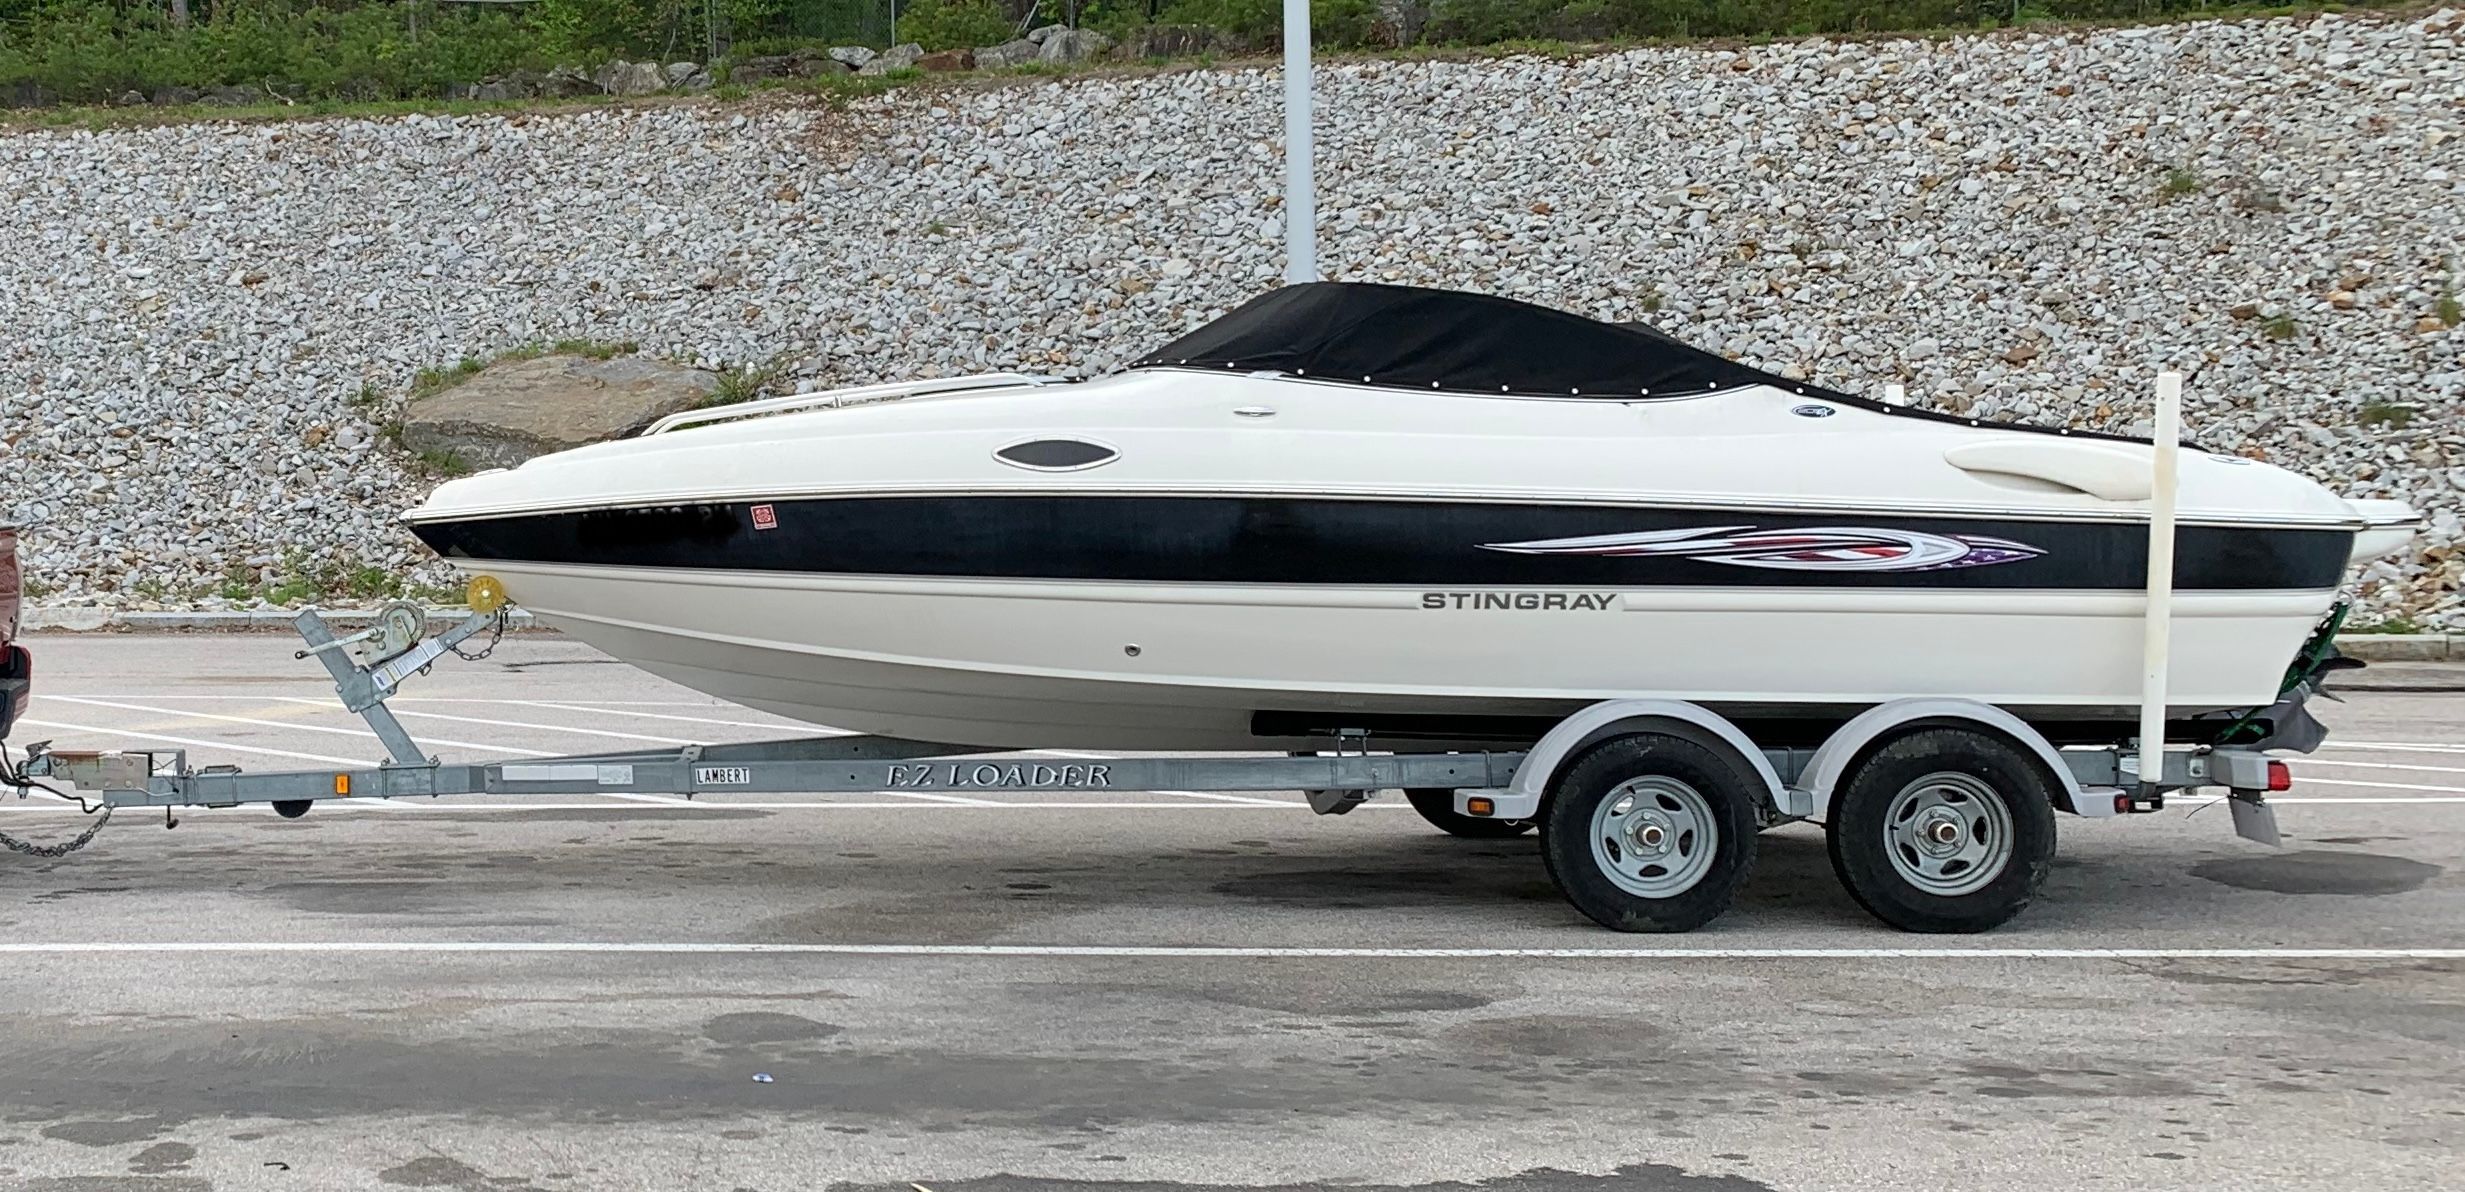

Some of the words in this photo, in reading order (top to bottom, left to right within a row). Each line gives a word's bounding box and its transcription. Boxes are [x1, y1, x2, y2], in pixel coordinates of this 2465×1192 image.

[1422, 592, 1617, 611] STINGRAY
[697, 768, 748, 783] LAMBERT
[886, 764, 934, 787] EZ
[948, 764, 1111, 787] LOADER
